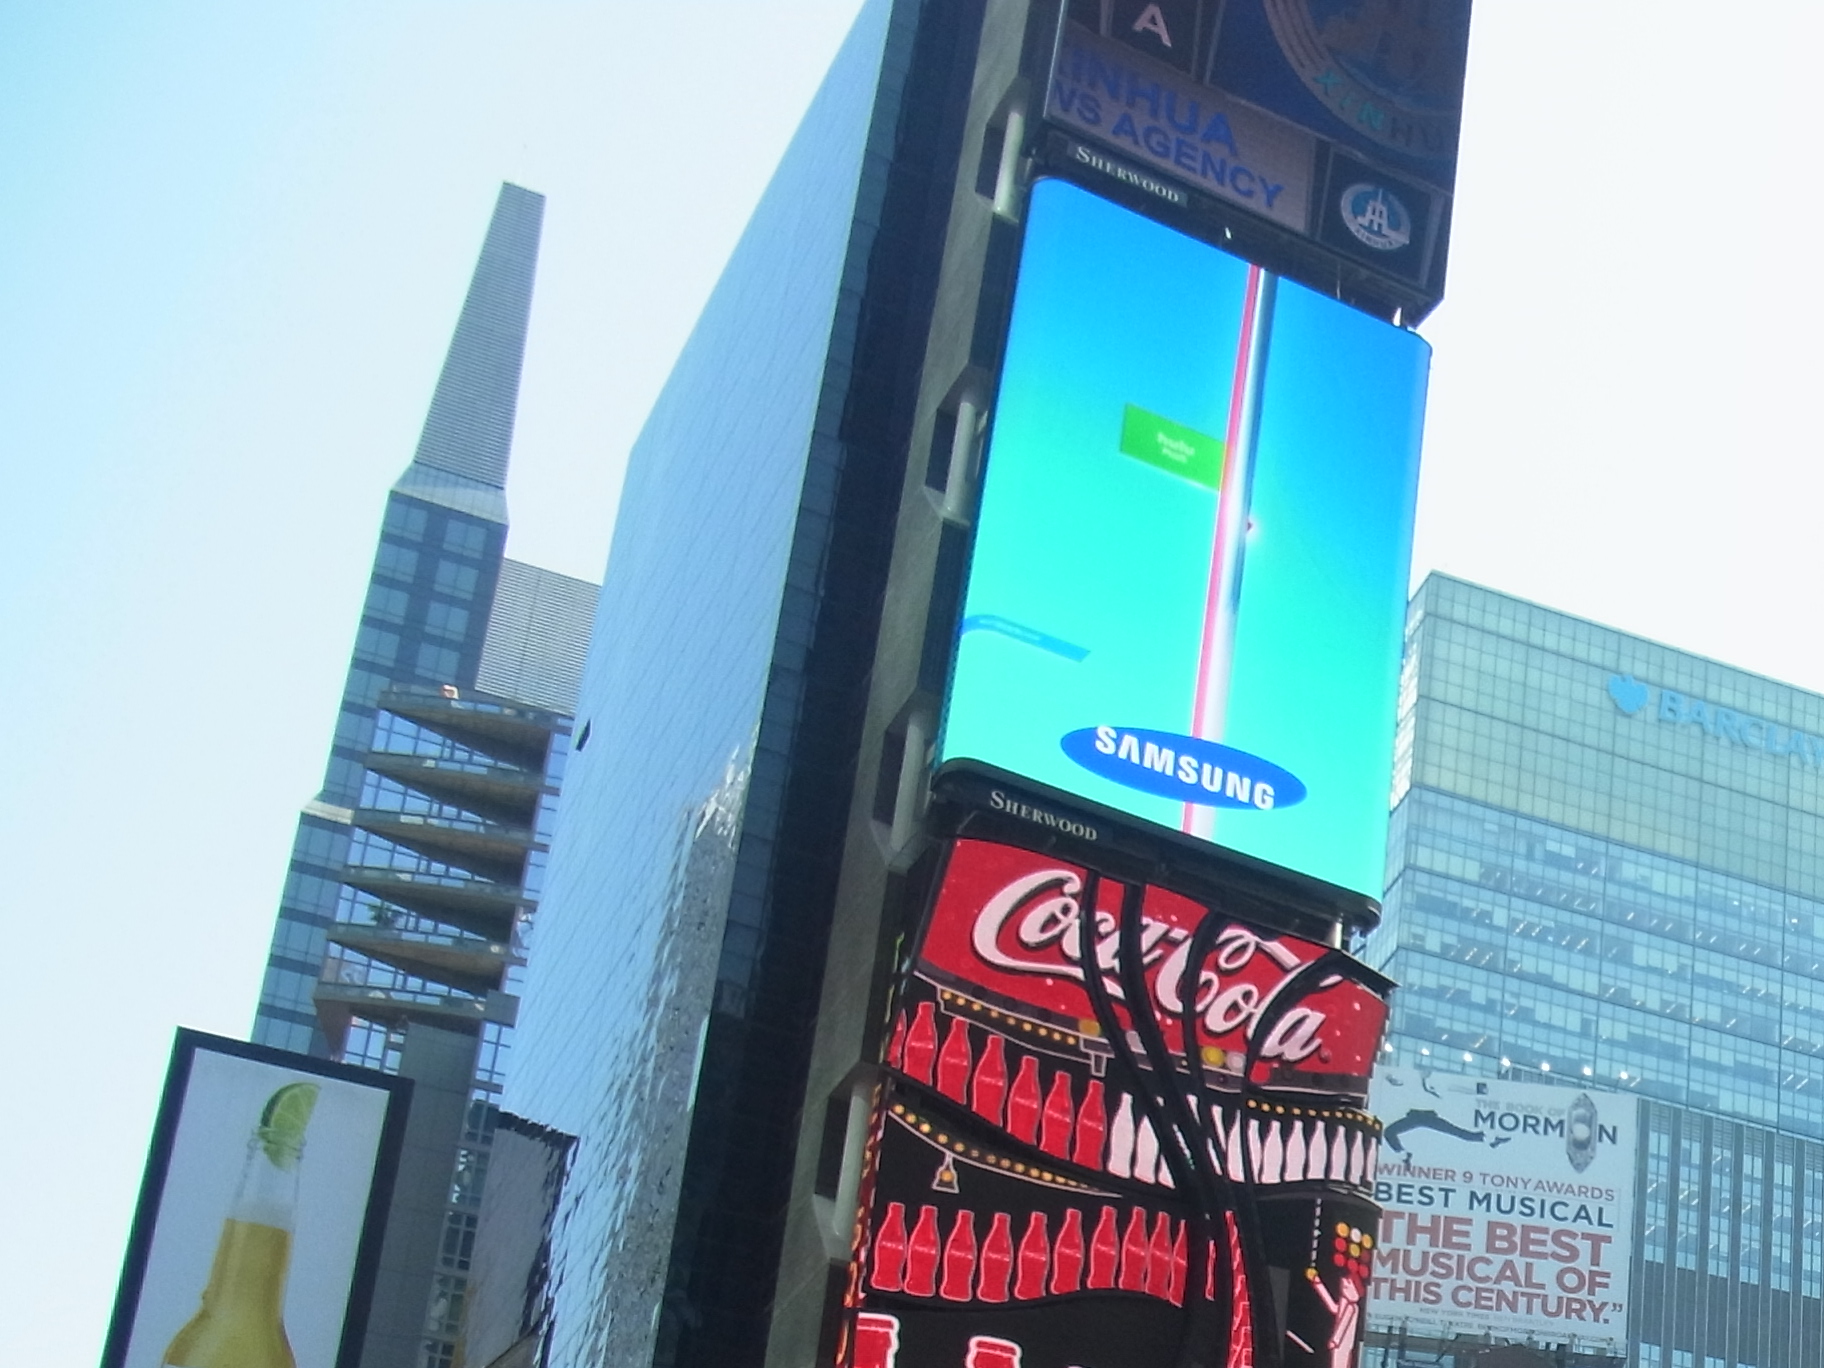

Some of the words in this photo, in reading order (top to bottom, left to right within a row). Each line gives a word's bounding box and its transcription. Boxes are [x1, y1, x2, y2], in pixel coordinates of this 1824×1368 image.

[1075, 145, 1180, 203] SHERWOOD
[1111, 112, 1285, 209] AGENCY
[1095, 725, 1275, 810] SAMSUNG
[989, 790, 1098, 842] SHERWOOD
[1374, 1181, 1457, 1208] BEST
[1468, 1190, 1614, 1229] MUSICAL
[1378, 1163, 1456, 1182] WINNER
[1462, 1170, 1473, 1183] 9
[1479, 1172, 1535, 1190] TONY
[1535, 1180, 1615, 1202] AWARDS
[1380, 1210, 1474, 1252] THE
[1486, 1220, 1613, 1267] BEST
[1371, 1277, 1443, 1306] THIS
[1374, 1248, 1546, 1291] MUSICAL
[1555, 1266, 1612, 1297] OF
